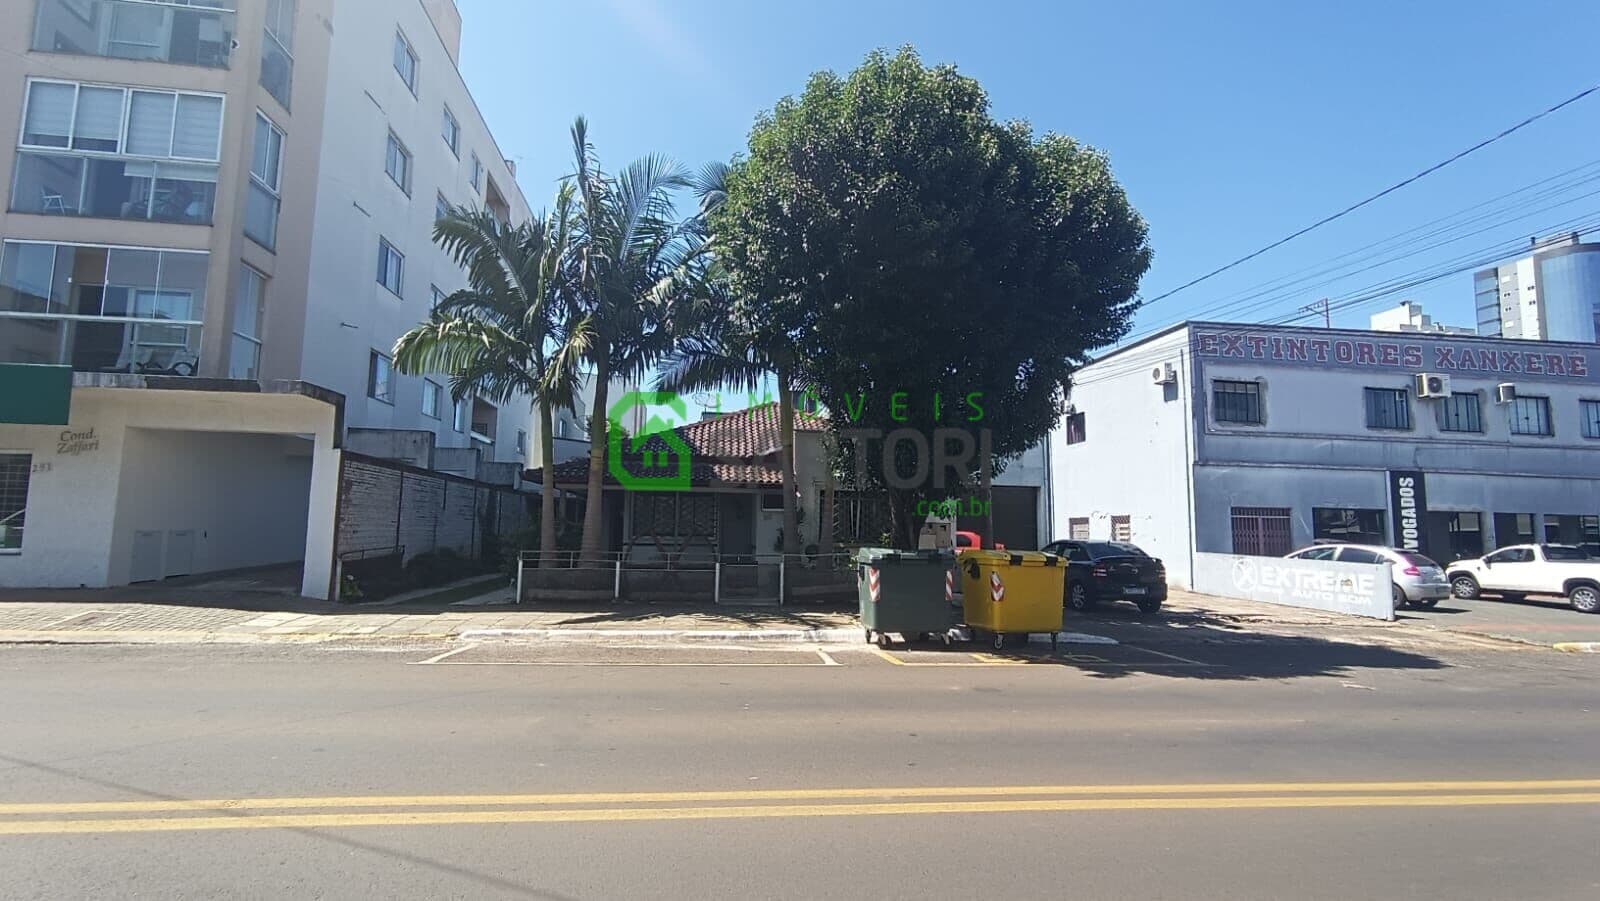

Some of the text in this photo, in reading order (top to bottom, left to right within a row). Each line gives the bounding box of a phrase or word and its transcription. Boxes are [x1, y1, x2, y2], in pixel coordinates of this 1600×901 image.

[1197, 333, 1424, 367] EXTINTORES
[61, 428, 97, 441] Cond.
[1397, 477, 1419, 552] VOGADOS
